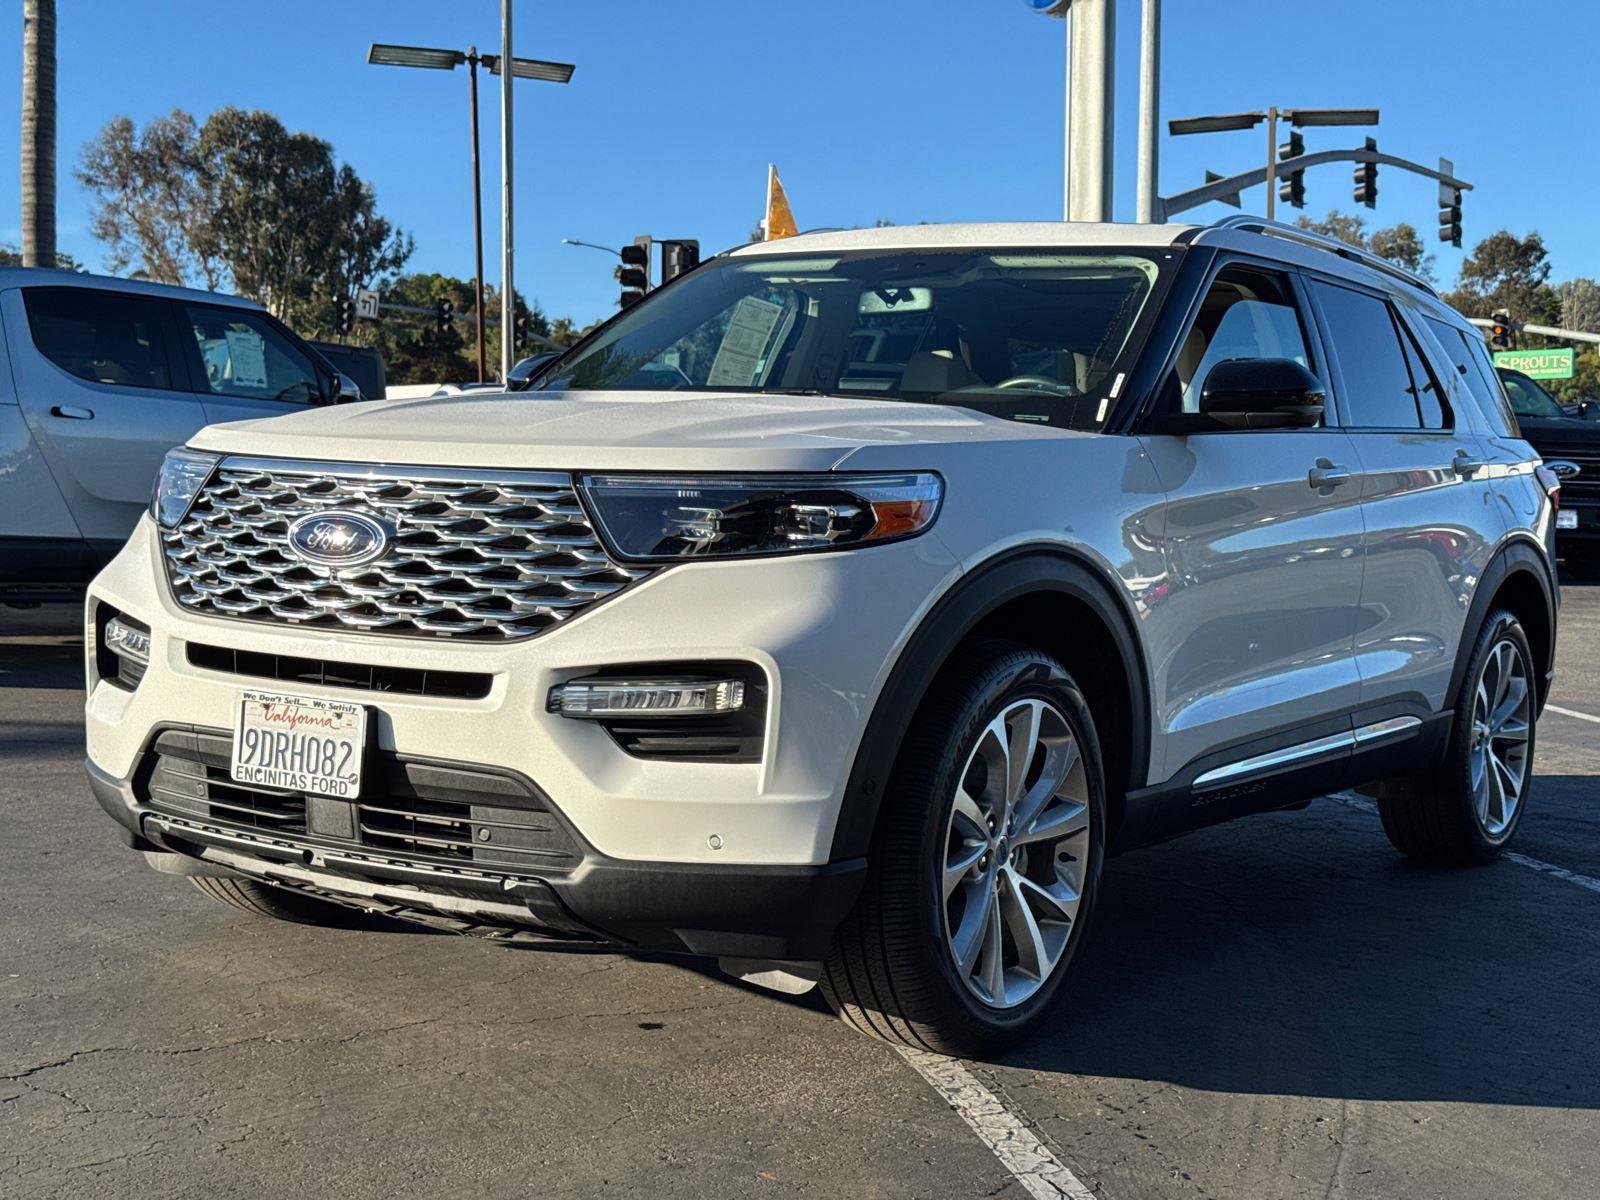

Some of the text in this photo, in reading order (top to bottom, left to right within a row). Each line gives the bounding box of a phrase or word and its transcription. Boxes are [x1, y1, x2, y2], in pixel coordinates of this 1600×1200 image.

[1497, 355, 1570, 369] SPROUTS
[243, 692, 257, 700] We
[259, 694, 281, 702] Don't
[313, 701, 328, 709] We
[329, 703, 357, 713] Satisfy
[264, 703, 340, 730] California
[244, 728, 353, 779] 9DRH082
[236, 765, 348, 796] ENCINITAS FORD
